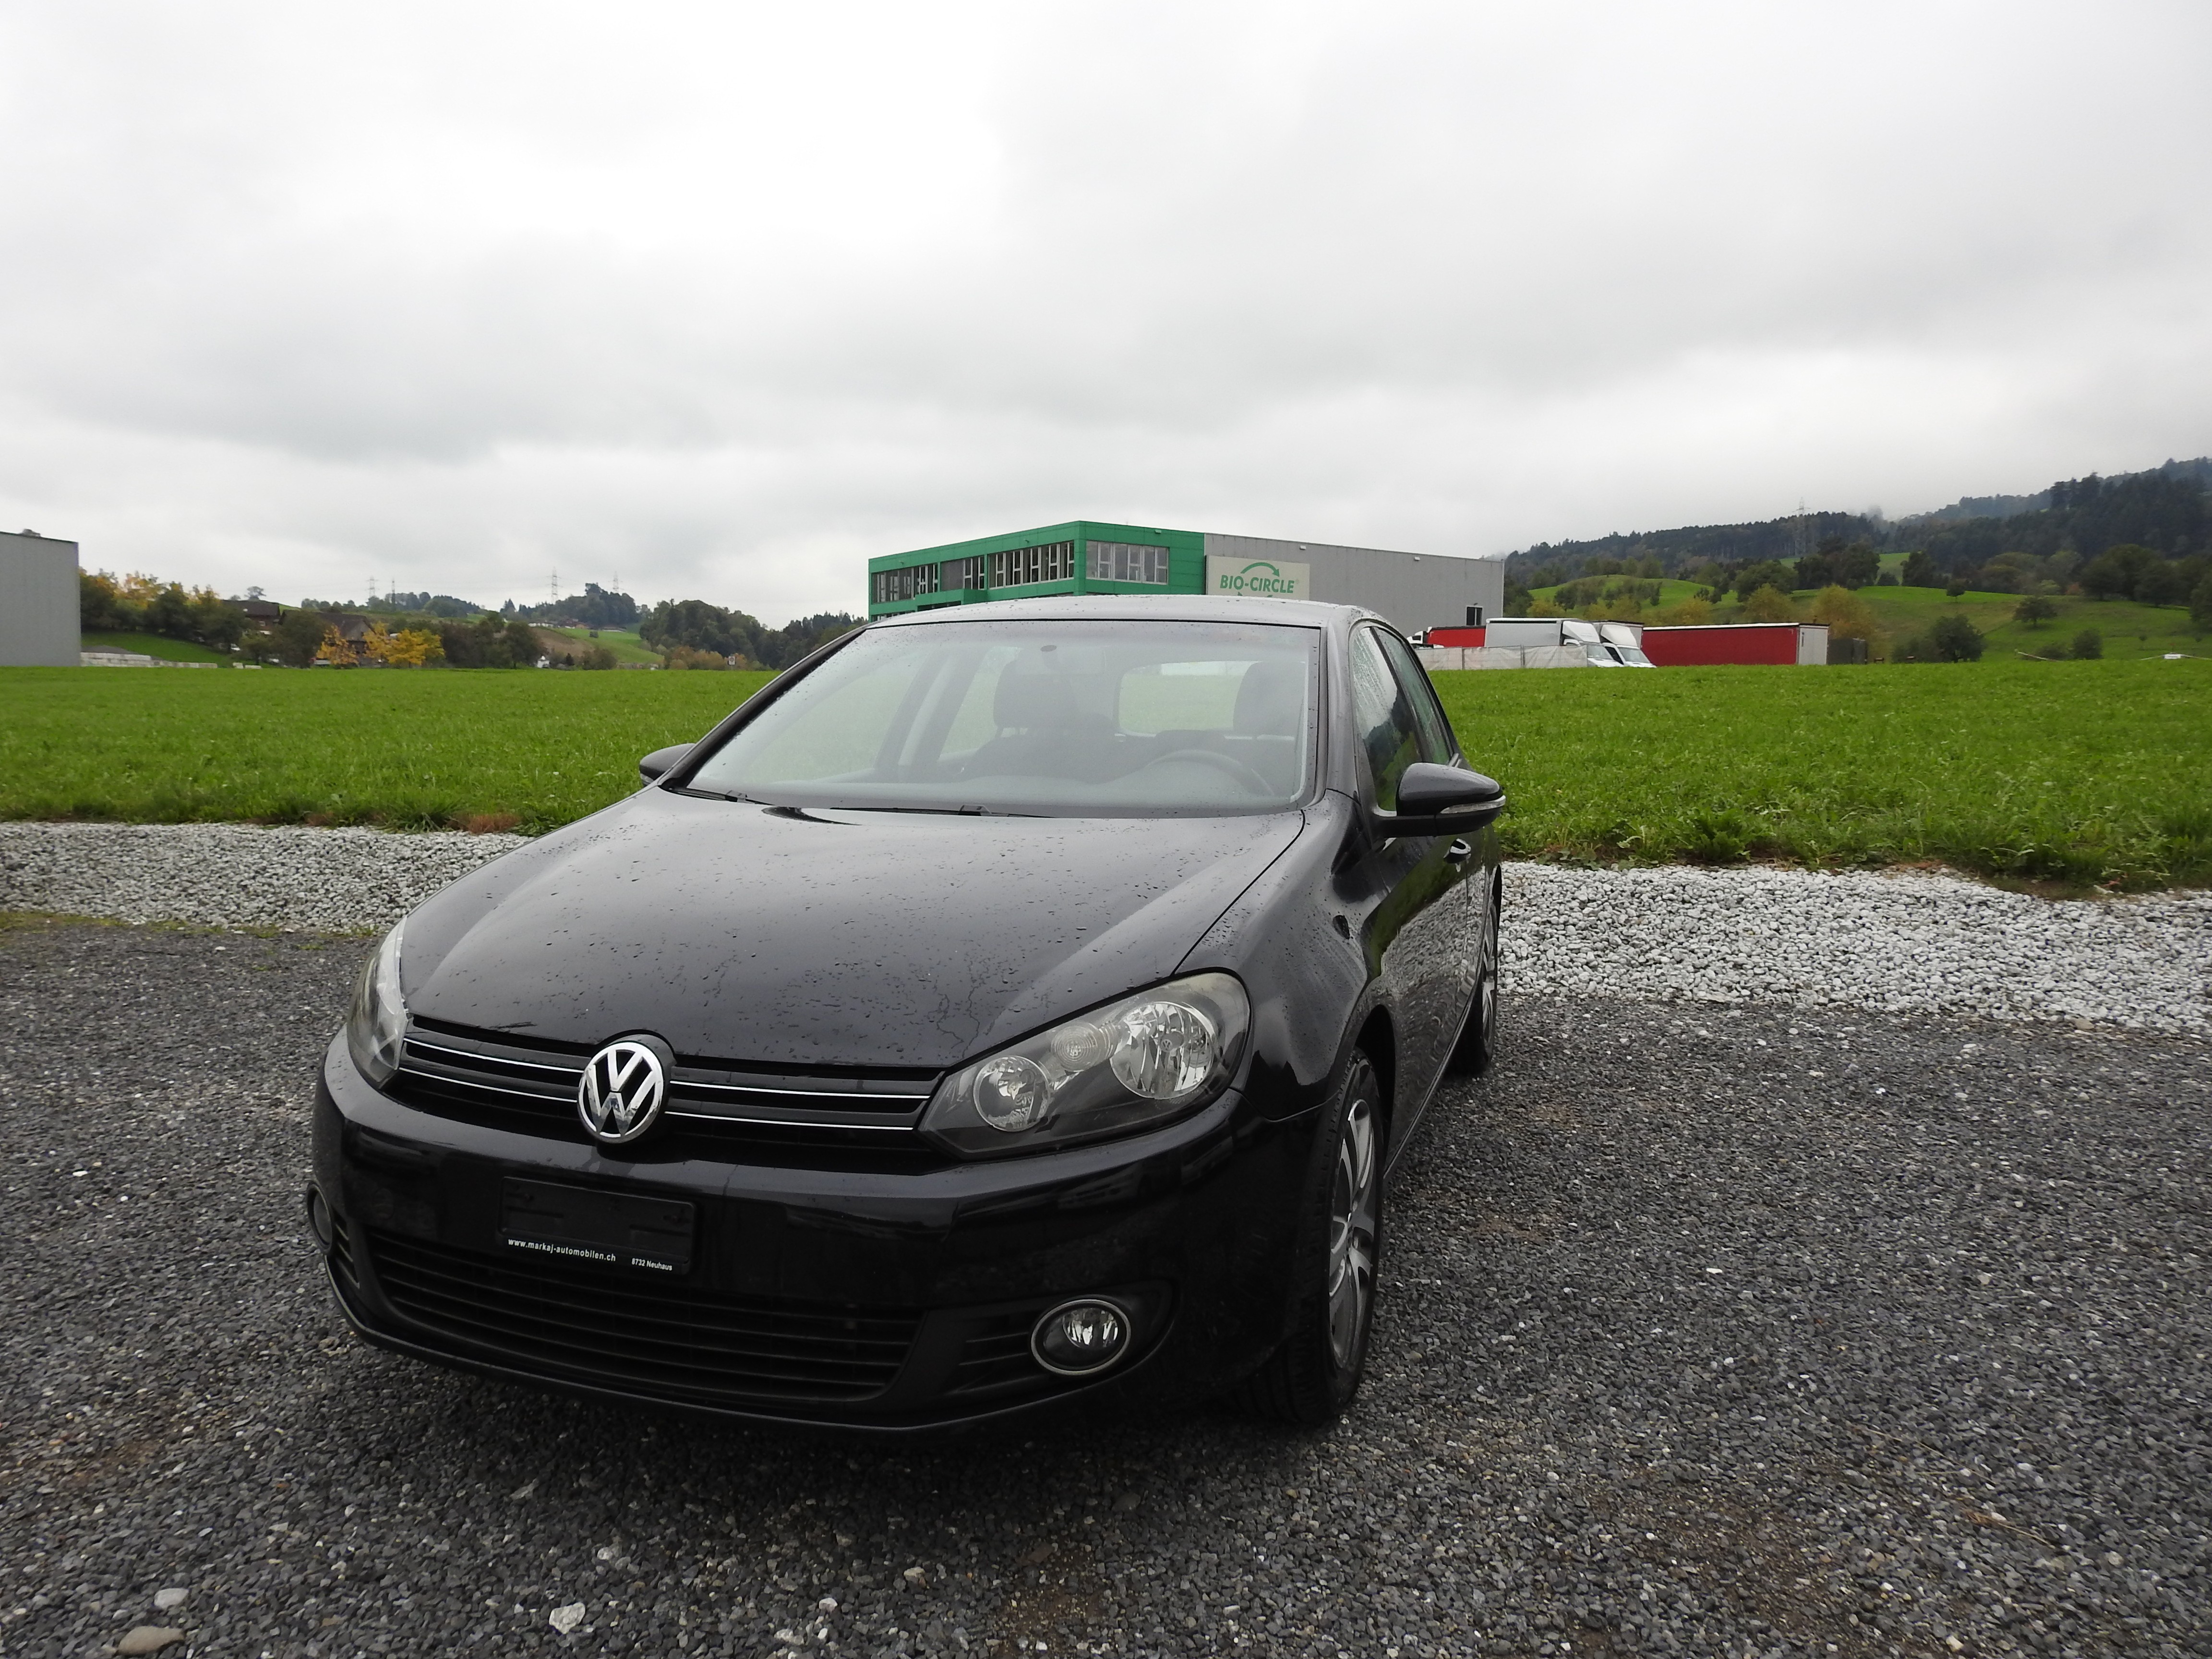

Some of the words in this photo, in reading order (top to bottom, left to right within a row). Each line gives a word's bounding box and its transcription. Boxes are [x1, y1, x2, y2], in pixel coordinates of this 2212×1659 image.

[1220, 575, 1295, 593] BIO-CIRCLE
[580, 1045, 660, 1139] VW
[508, 1239, 616, 1262] www.markaj-automobilen.ch
[631, 1258, 646, 1267] 8732
[646, 1260, 673, 1271] Neuhaus
